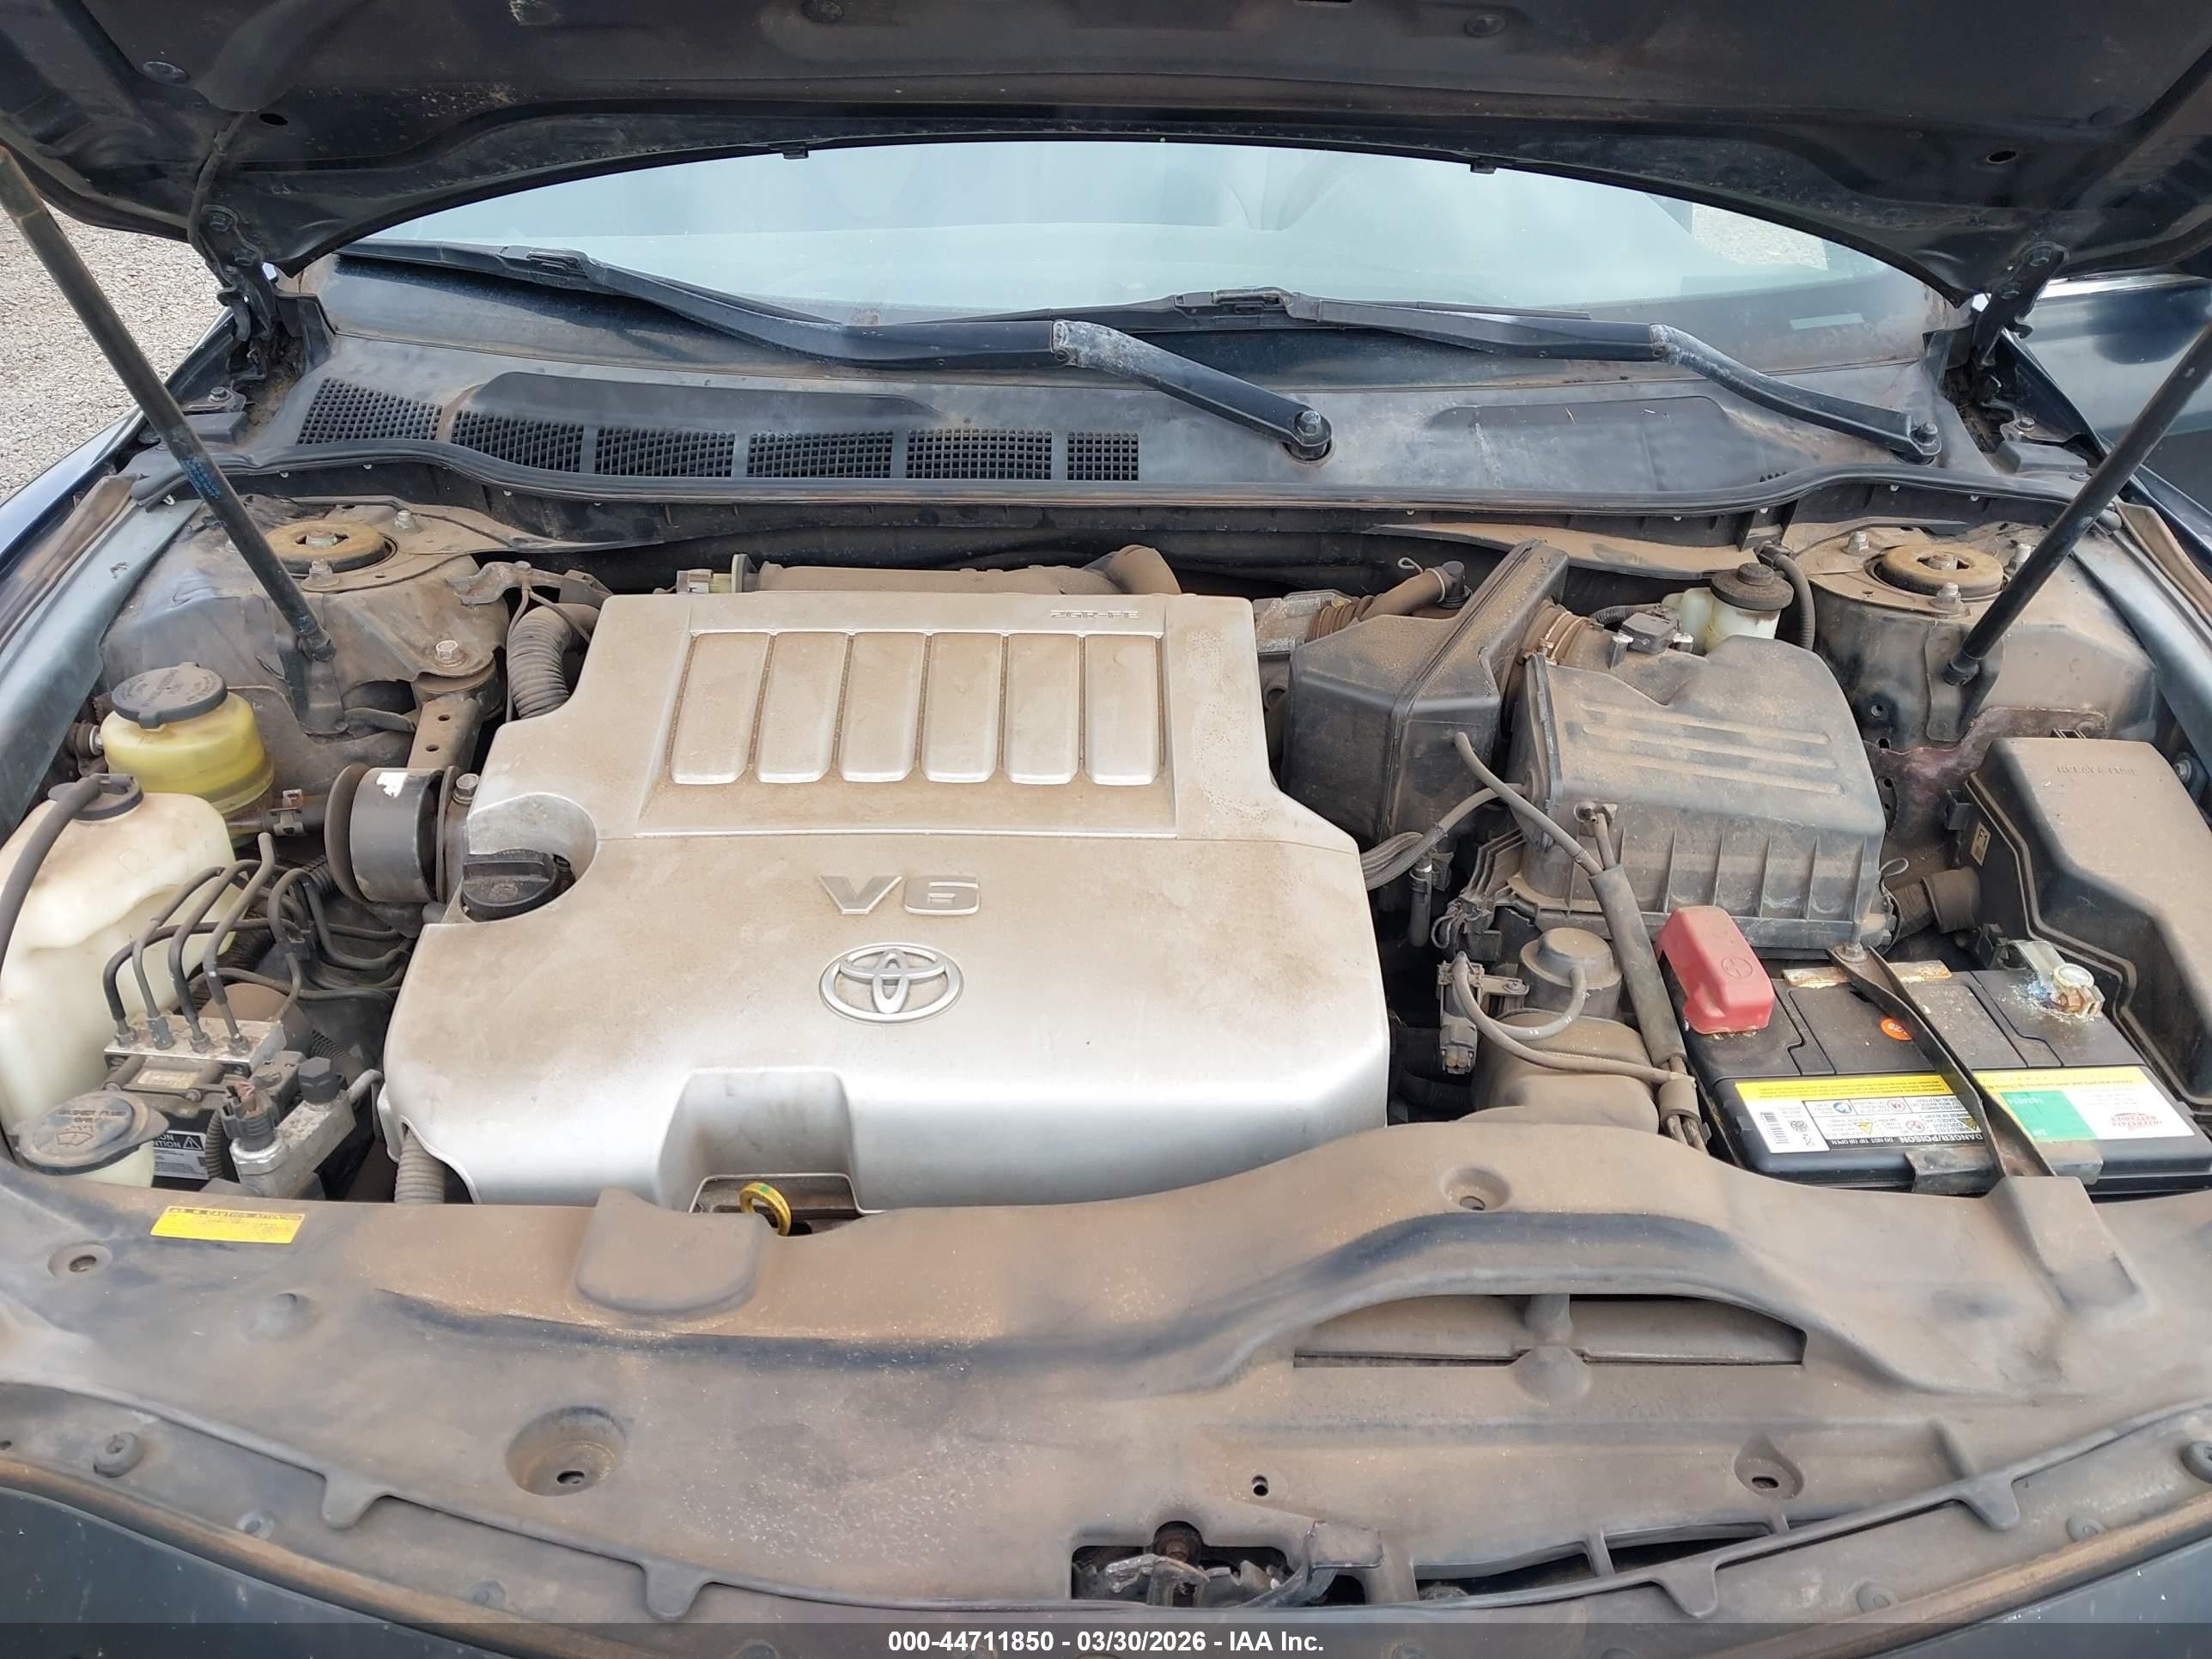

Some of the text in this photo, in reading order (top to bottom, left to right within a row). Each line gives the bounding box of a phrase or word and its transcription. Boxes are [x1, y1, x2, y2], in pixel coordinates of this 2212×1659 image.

[1050, 609, 1140, 619] 2GR-FE
[818, 875, 980, 915] V6
[1899, 1133, 1984, 1144] DANGER/POISON
